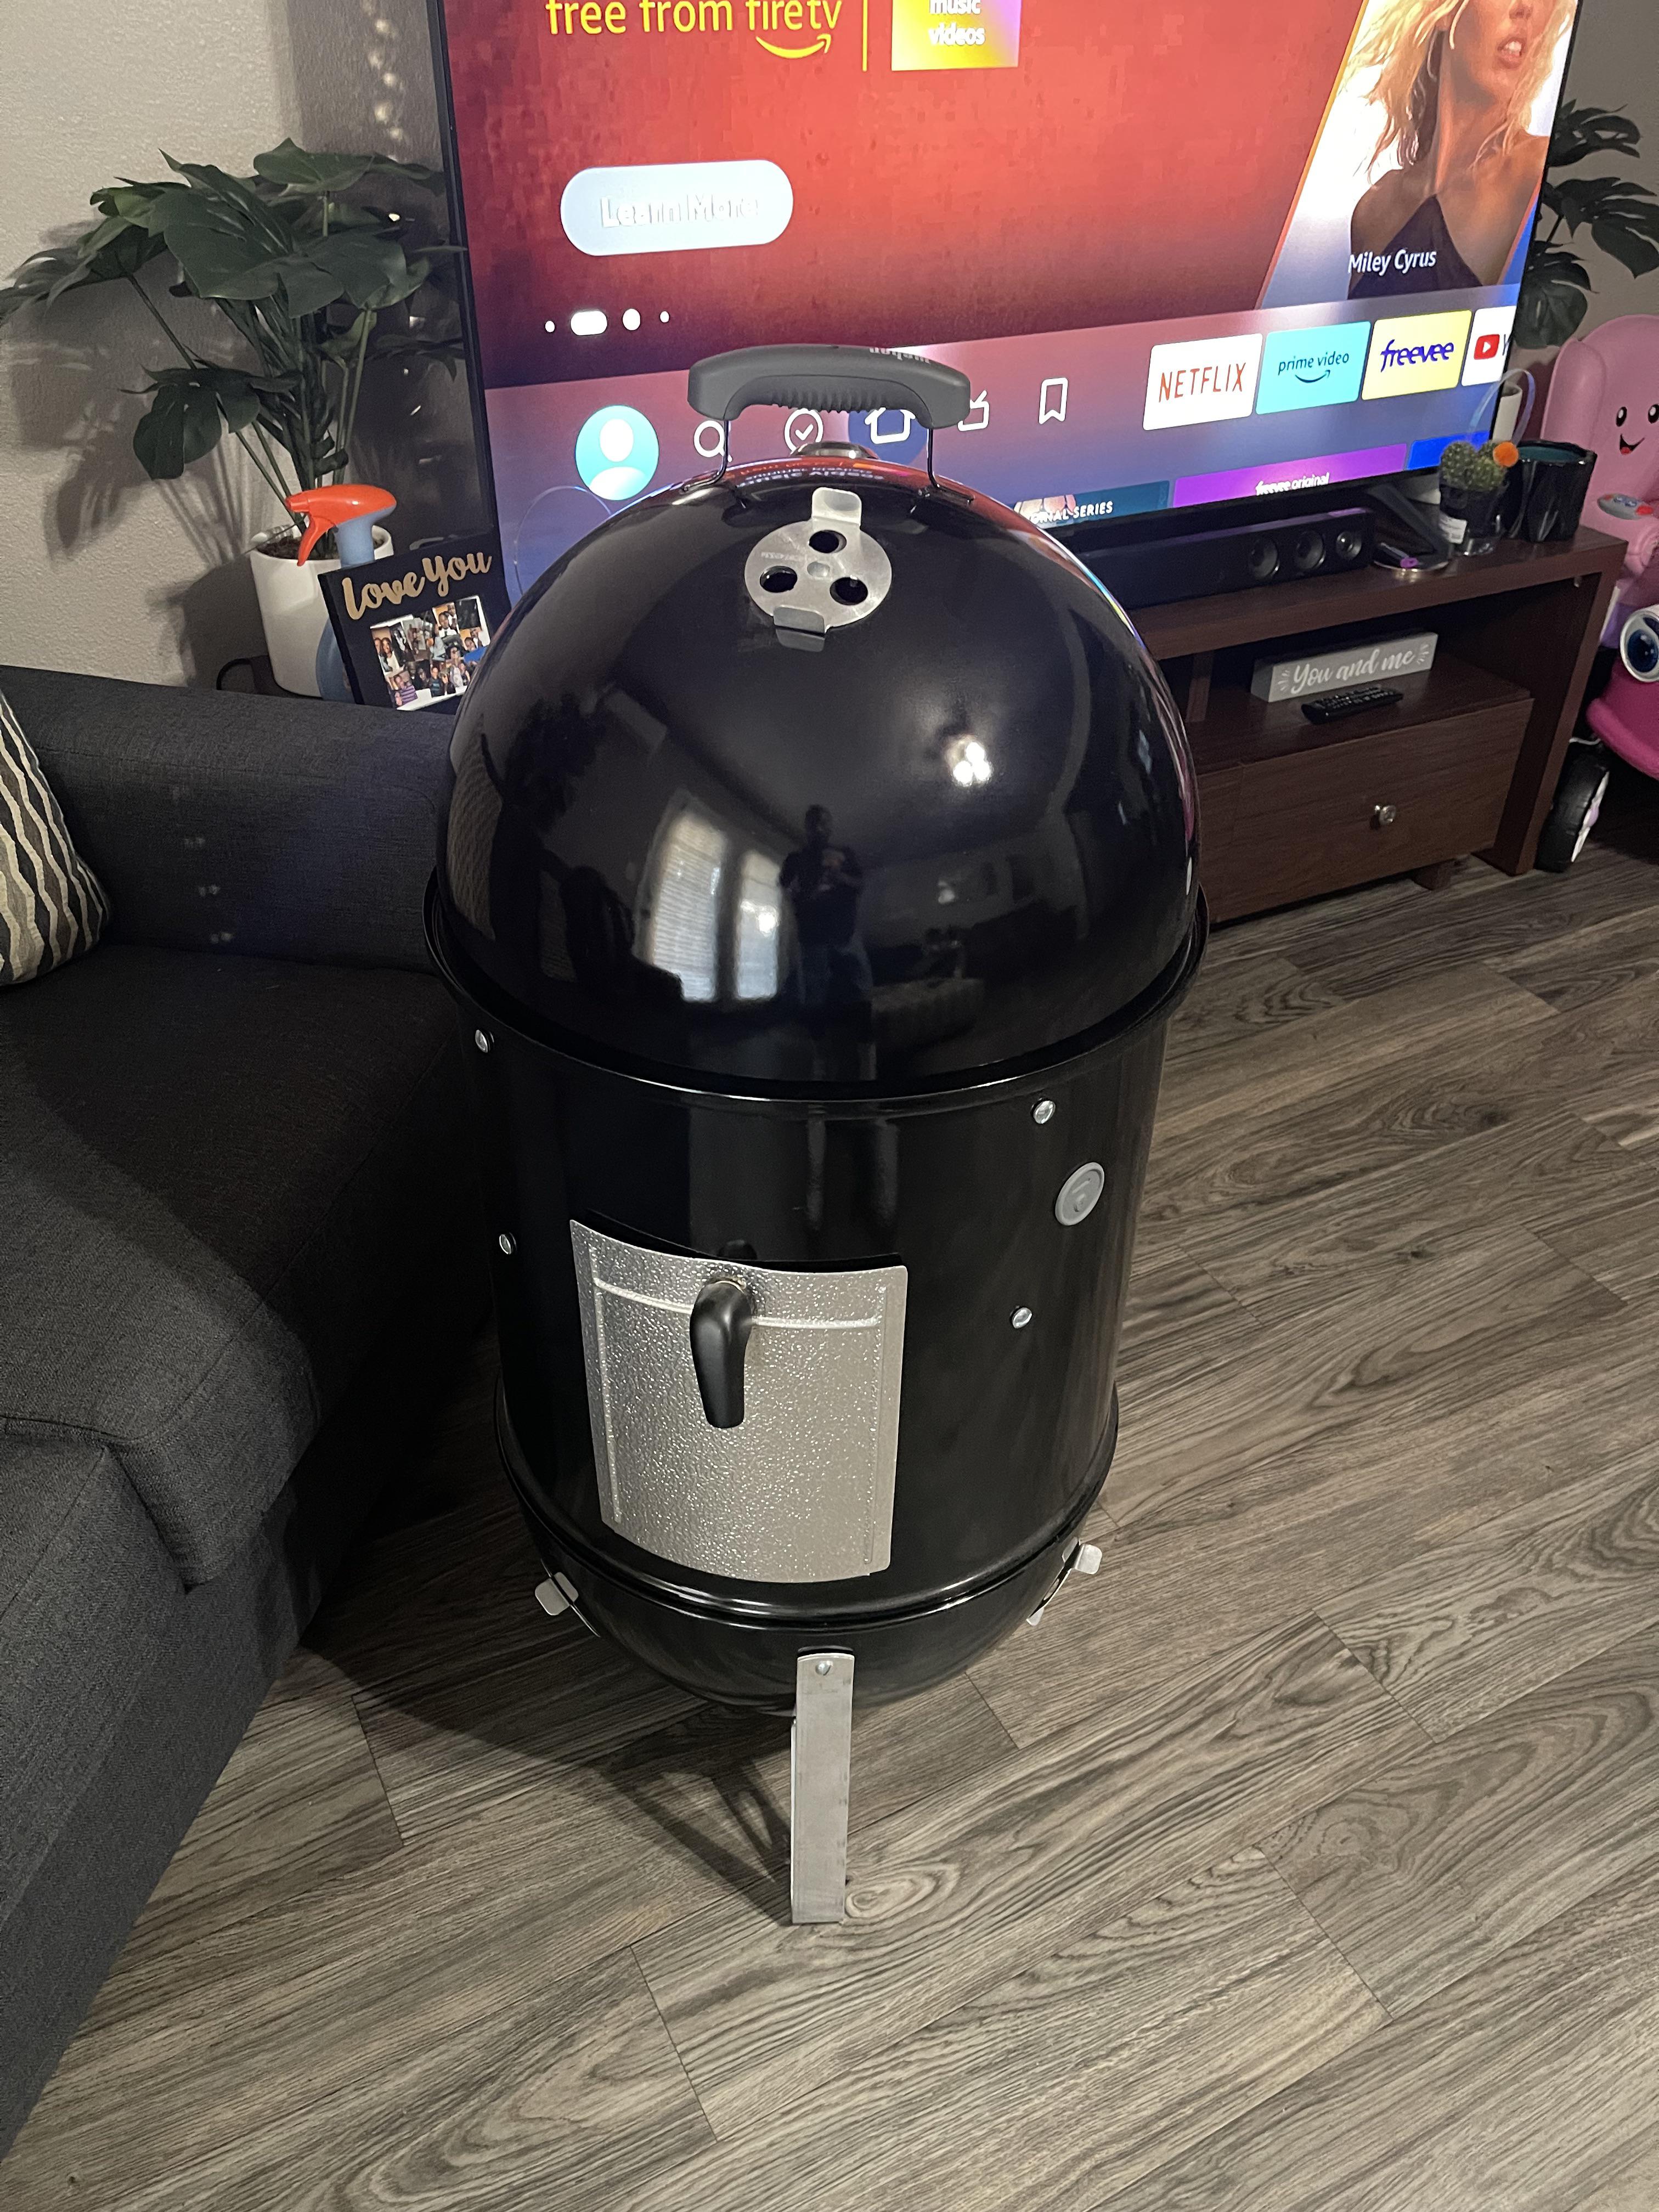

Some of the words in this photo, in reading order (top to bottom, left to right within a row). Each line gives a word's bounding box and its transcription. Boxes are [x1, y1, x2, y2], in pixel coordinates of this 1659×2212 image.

[545, 0, 627, 34] free
[639, 0, 733, 32] from
[928, 22, 985, 46] videos
[600, 196, 681, 228] Learn
[687, 194, 759, 222] More
[1348, 251, 1392, 276] Miley
[1394, 249, 1437, 274] Cyrus
[1278, 355, 1314, 375] prime
[1317, 351, 1350, 366] video
[1380, 339, 1454, 373] freevee
[1159, 362, 1246, 403] NETFLIX
[1073, 500, 1114, 519] SERIES
[1336, 649, 1380, 680] and
[1381, 651, 1415, 670] me
